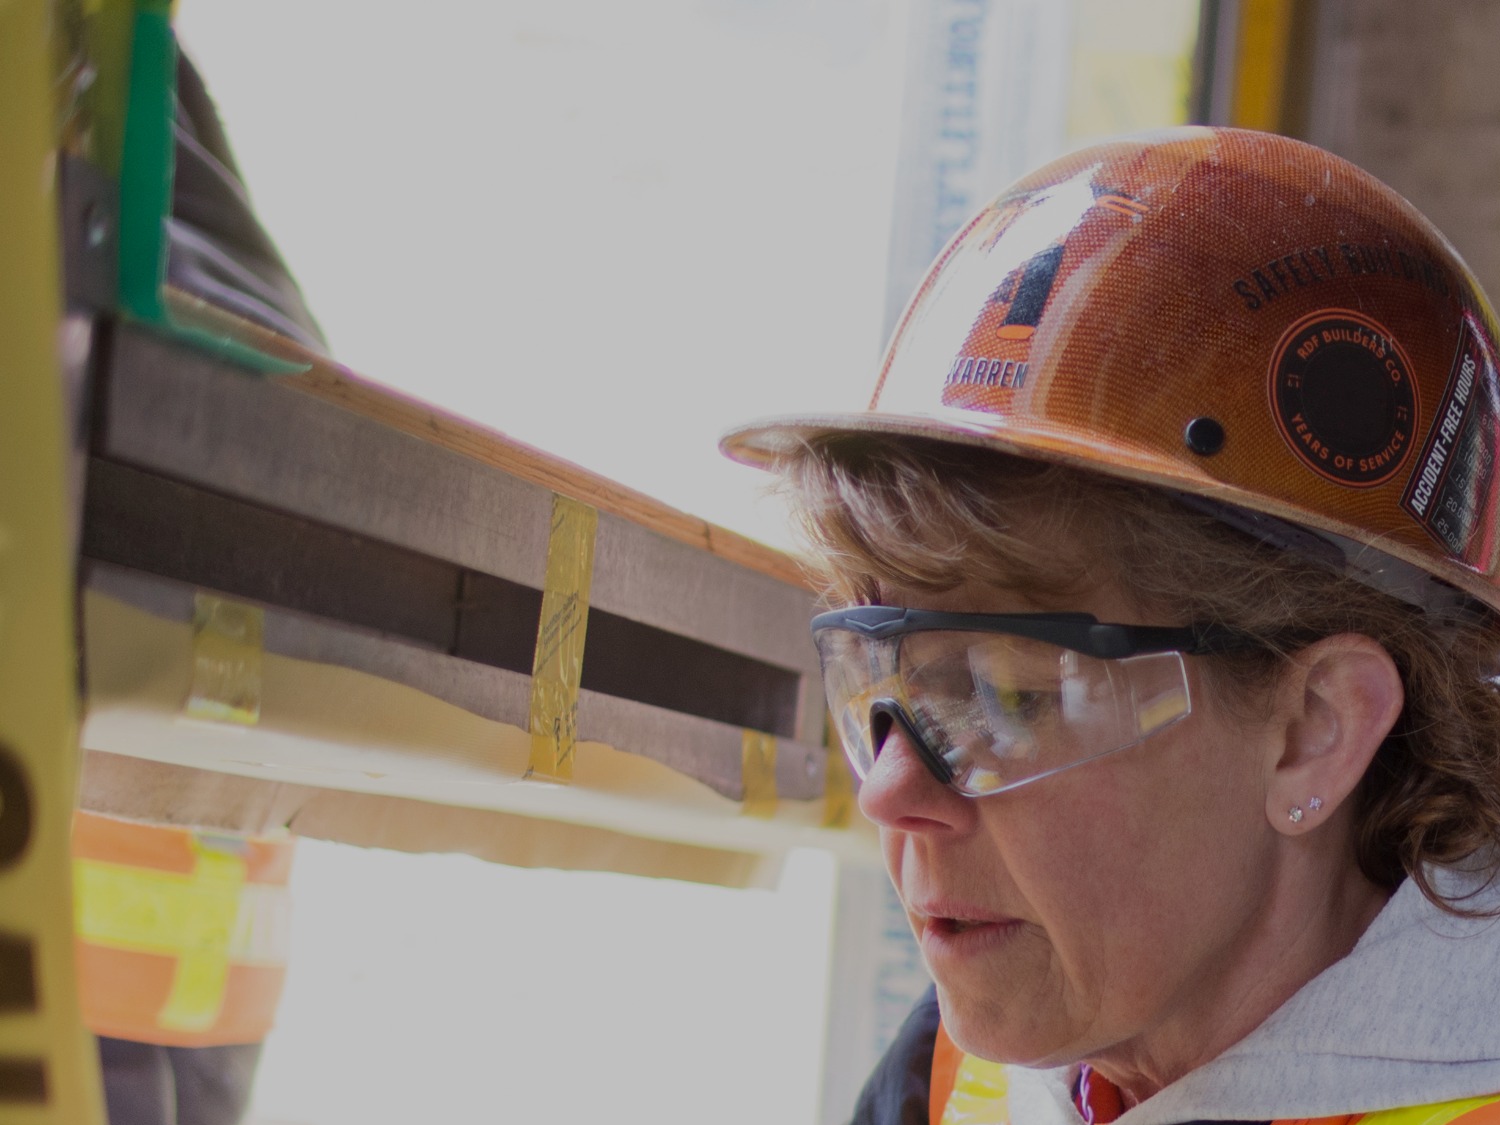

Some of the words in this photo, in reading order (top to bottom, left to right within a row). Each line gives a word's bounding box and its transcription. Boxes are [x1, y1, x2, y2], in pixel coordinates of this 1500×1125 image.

[1232, 246, 1336, 310] SAFELY
[1297, 335, 1319, 360] RDF
[1322, 328, 1386, 359] BUILDERS
[1292, 413, 1328, 460] YEARS
[1334, 455, 1354, 471] OF
[1360, 430, 1405, 472] SERVICE
[1410, 399, 1464, 516] ACCIDENT-FREE
[1453, 353, 1477, 403] HOURS
